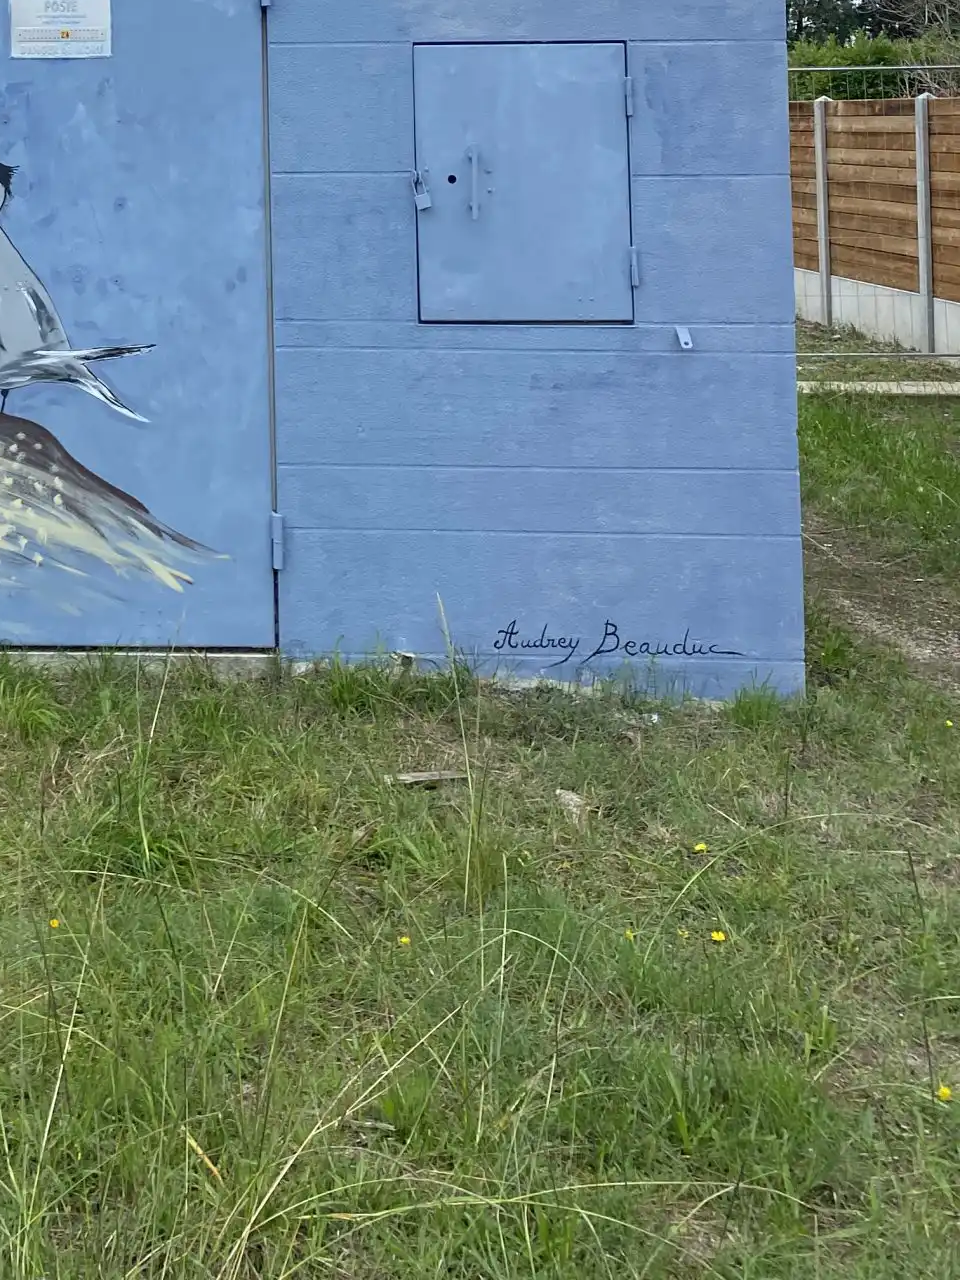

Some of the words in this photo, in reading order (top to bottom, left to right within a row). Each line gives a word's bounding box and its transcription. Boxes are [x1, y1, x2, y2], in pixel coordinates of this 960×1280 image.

[44, 0, 78, 13] POSTE
[493, 619, 580, 669] Audrey
[581, 619, 745, 664] Beauduc
